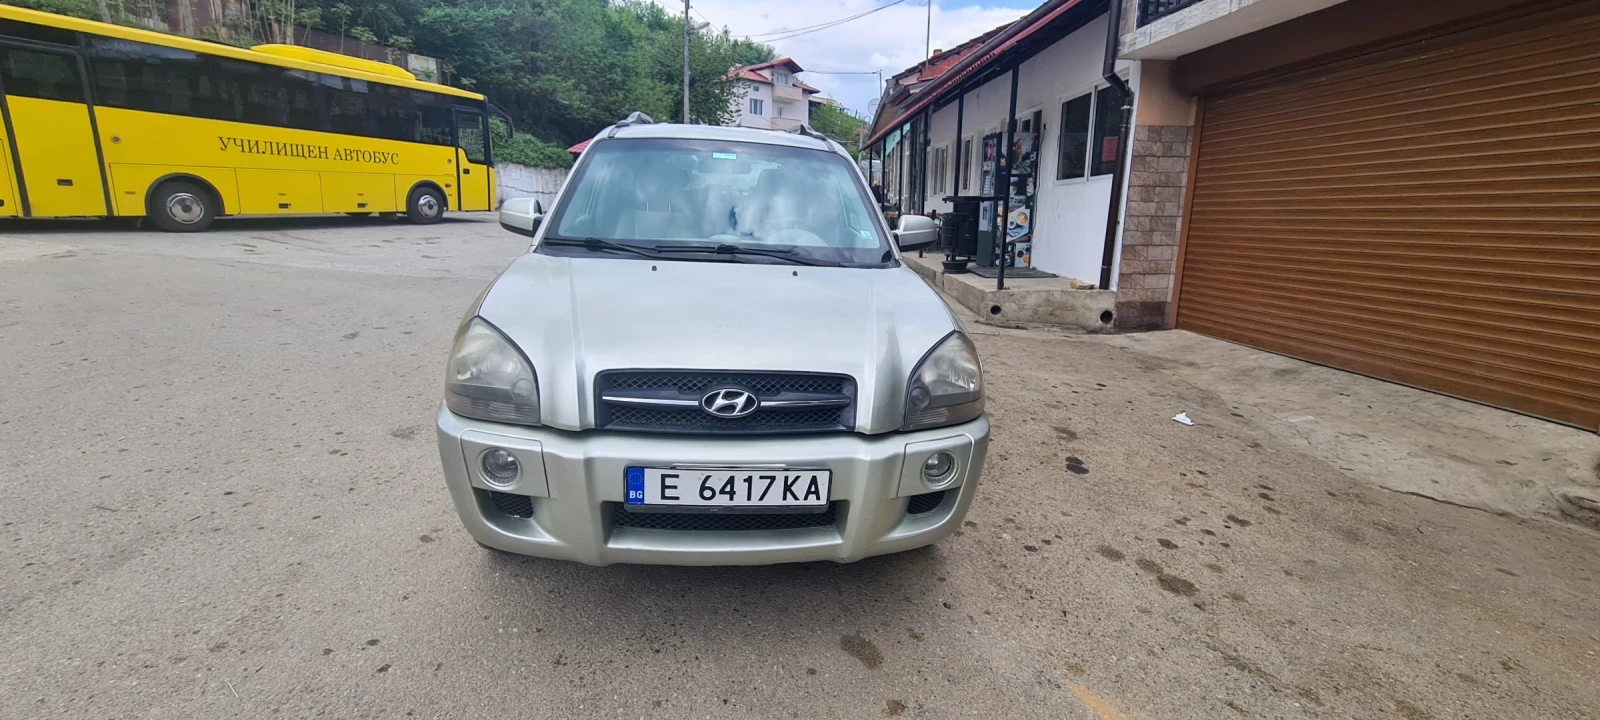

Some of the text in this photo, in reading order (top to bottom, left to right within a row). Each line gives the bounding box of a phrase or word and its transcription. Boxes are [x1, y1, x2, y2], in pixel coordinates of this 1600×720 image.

[218, 136, 400, 166] УЧИЛИЩЕН АВТОБУС
[629, 490, 643, 499] BG
[660, 473, 680, 501] E
